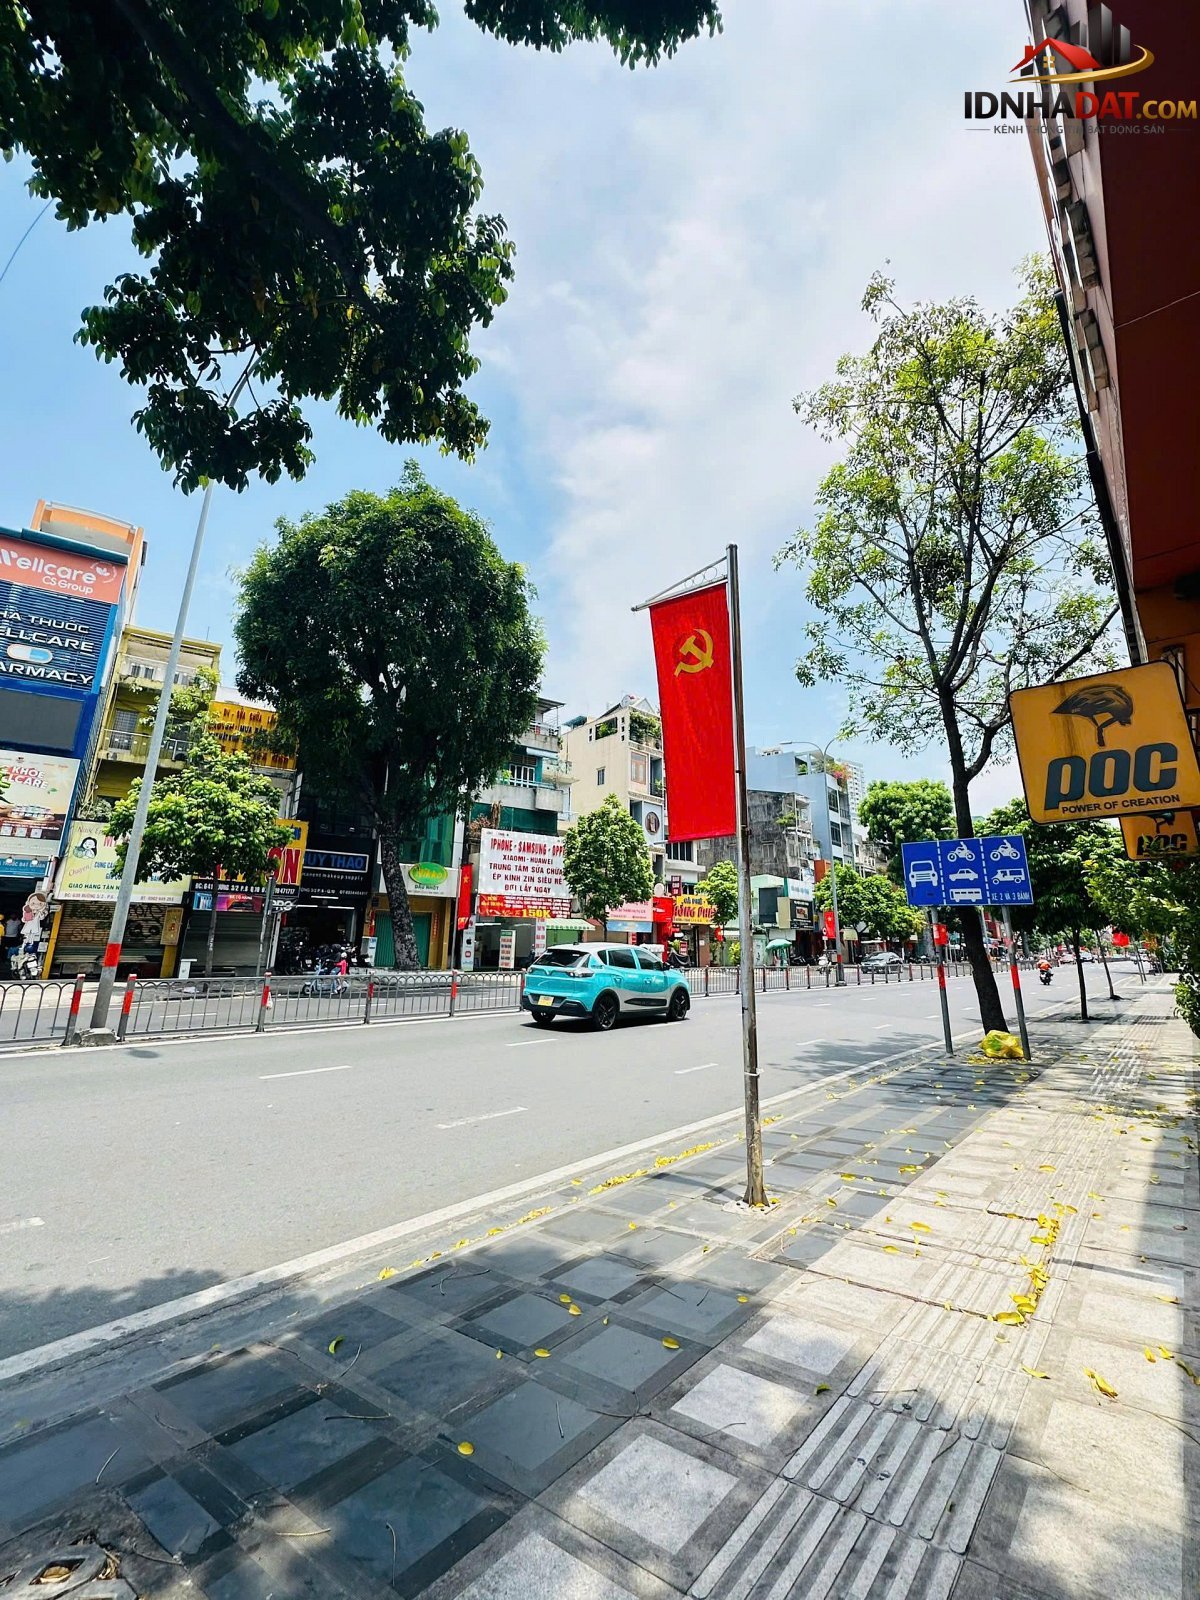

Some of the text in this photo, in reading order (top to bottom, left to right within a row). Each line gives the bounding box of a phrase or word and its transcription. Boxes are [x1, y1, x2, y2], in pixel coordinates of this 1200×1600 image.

[42, 575, 94, 595] CS Group
[1062, 794, 1181, 814] POWER OF CREATION
[490, 838, 512, 851] IPHONE
[518, 841, 547, 855] SAMSUNG
[502, 854, 525, 862] XIAOMI
[489, 862, 511, 870] TRUNG
[523, 875, 534, 883] ZIN
[991, 892, 998, 901] XE
[999, 892, 1004, 901] 2
[1011, 892, 1016, 901] 3
[522, 908, 551, 918] 150K
